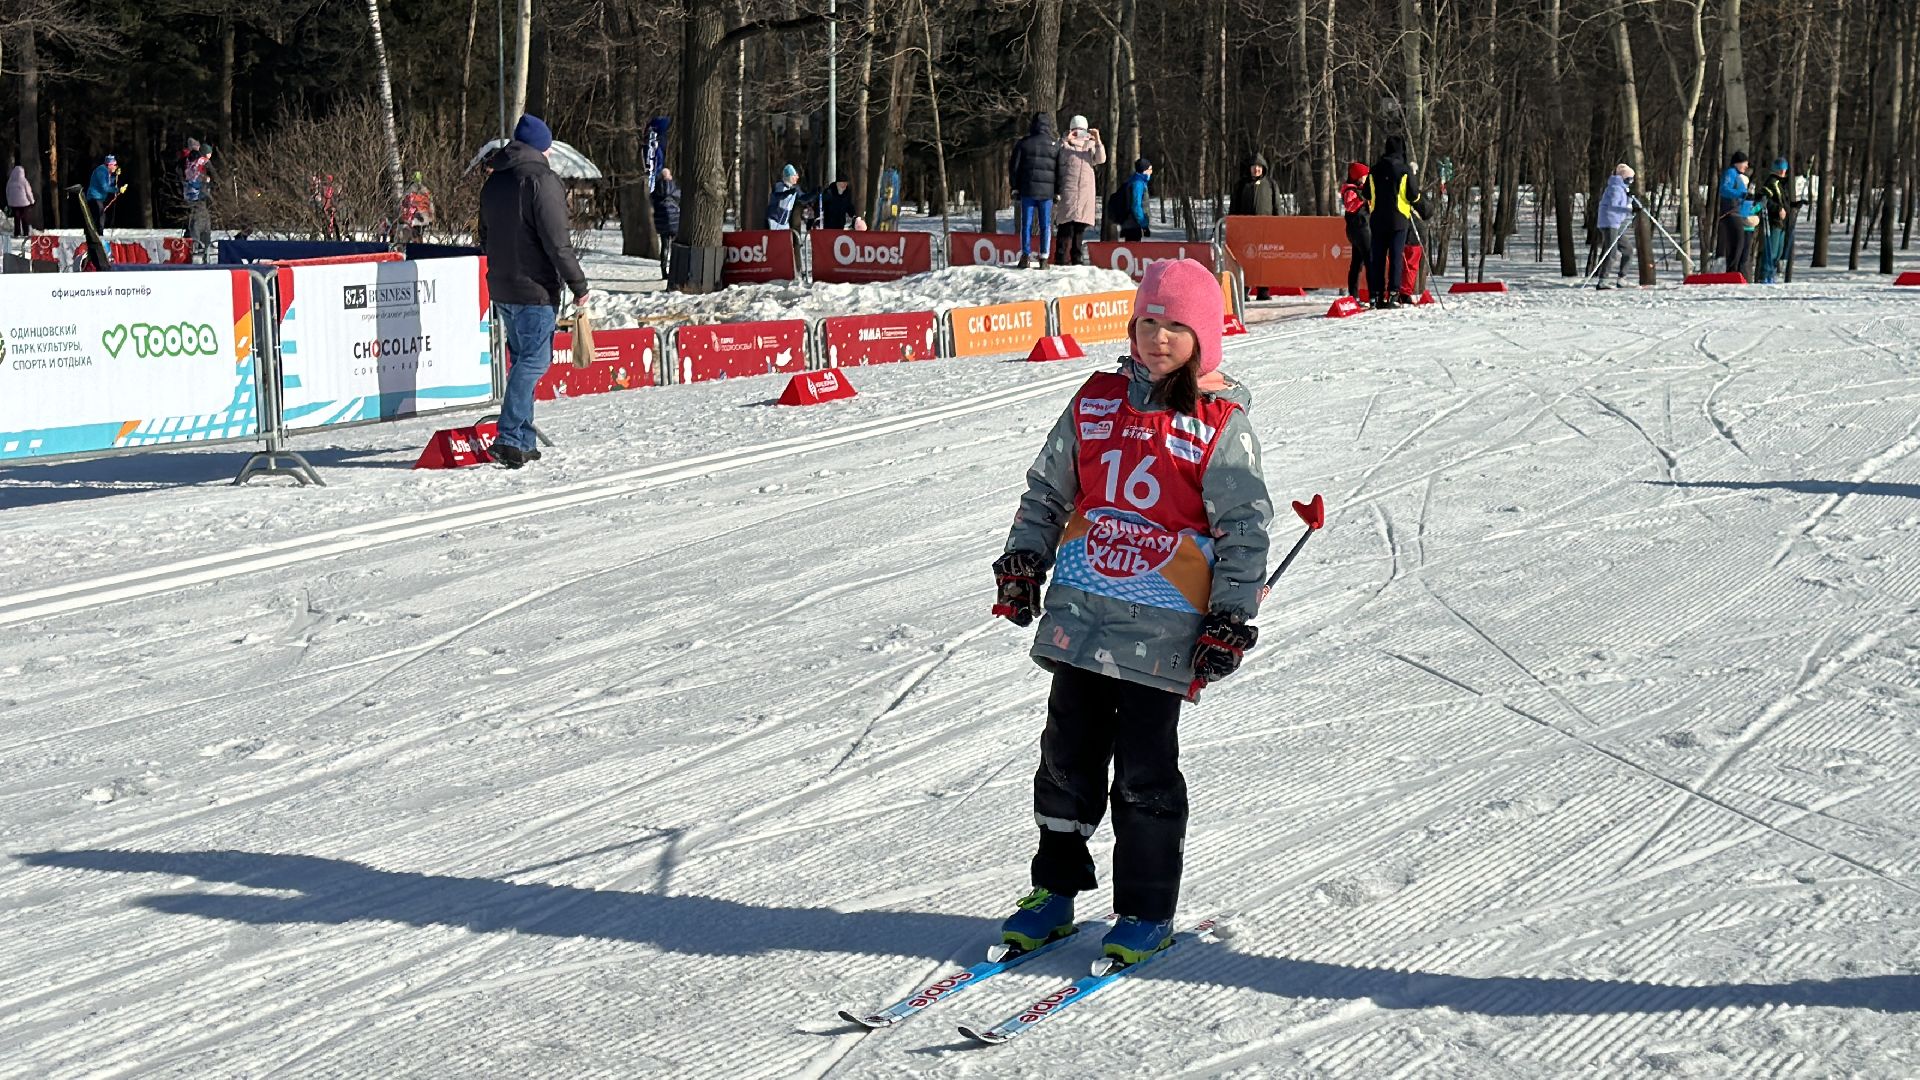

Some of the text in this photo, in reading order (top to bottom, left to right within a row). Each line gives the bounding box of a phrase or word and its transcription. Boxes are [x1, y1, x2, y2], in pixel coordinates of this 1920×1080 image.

[51, 285, 152, 300] официальный партнёр
[368, 286, 412, 303] BUSINESS
[1072, 300, 1129, 321] CHOCOLATE
[968, 311, 1033, 334] CHOCOLATE
[10, 323, 77, 340] ОДИНЦОВСКИЙ
[858, 327, 881, 342] ЗИМА
[11, 340, 83, 355] ПАРК КУЛЬТУРЫ,
[353, 335, 432, 360] CHOCOLATE
[12, 355, 93, 371] СПОРТА И ОТДЫХА
[1100, 449, 1161, 510] 16
